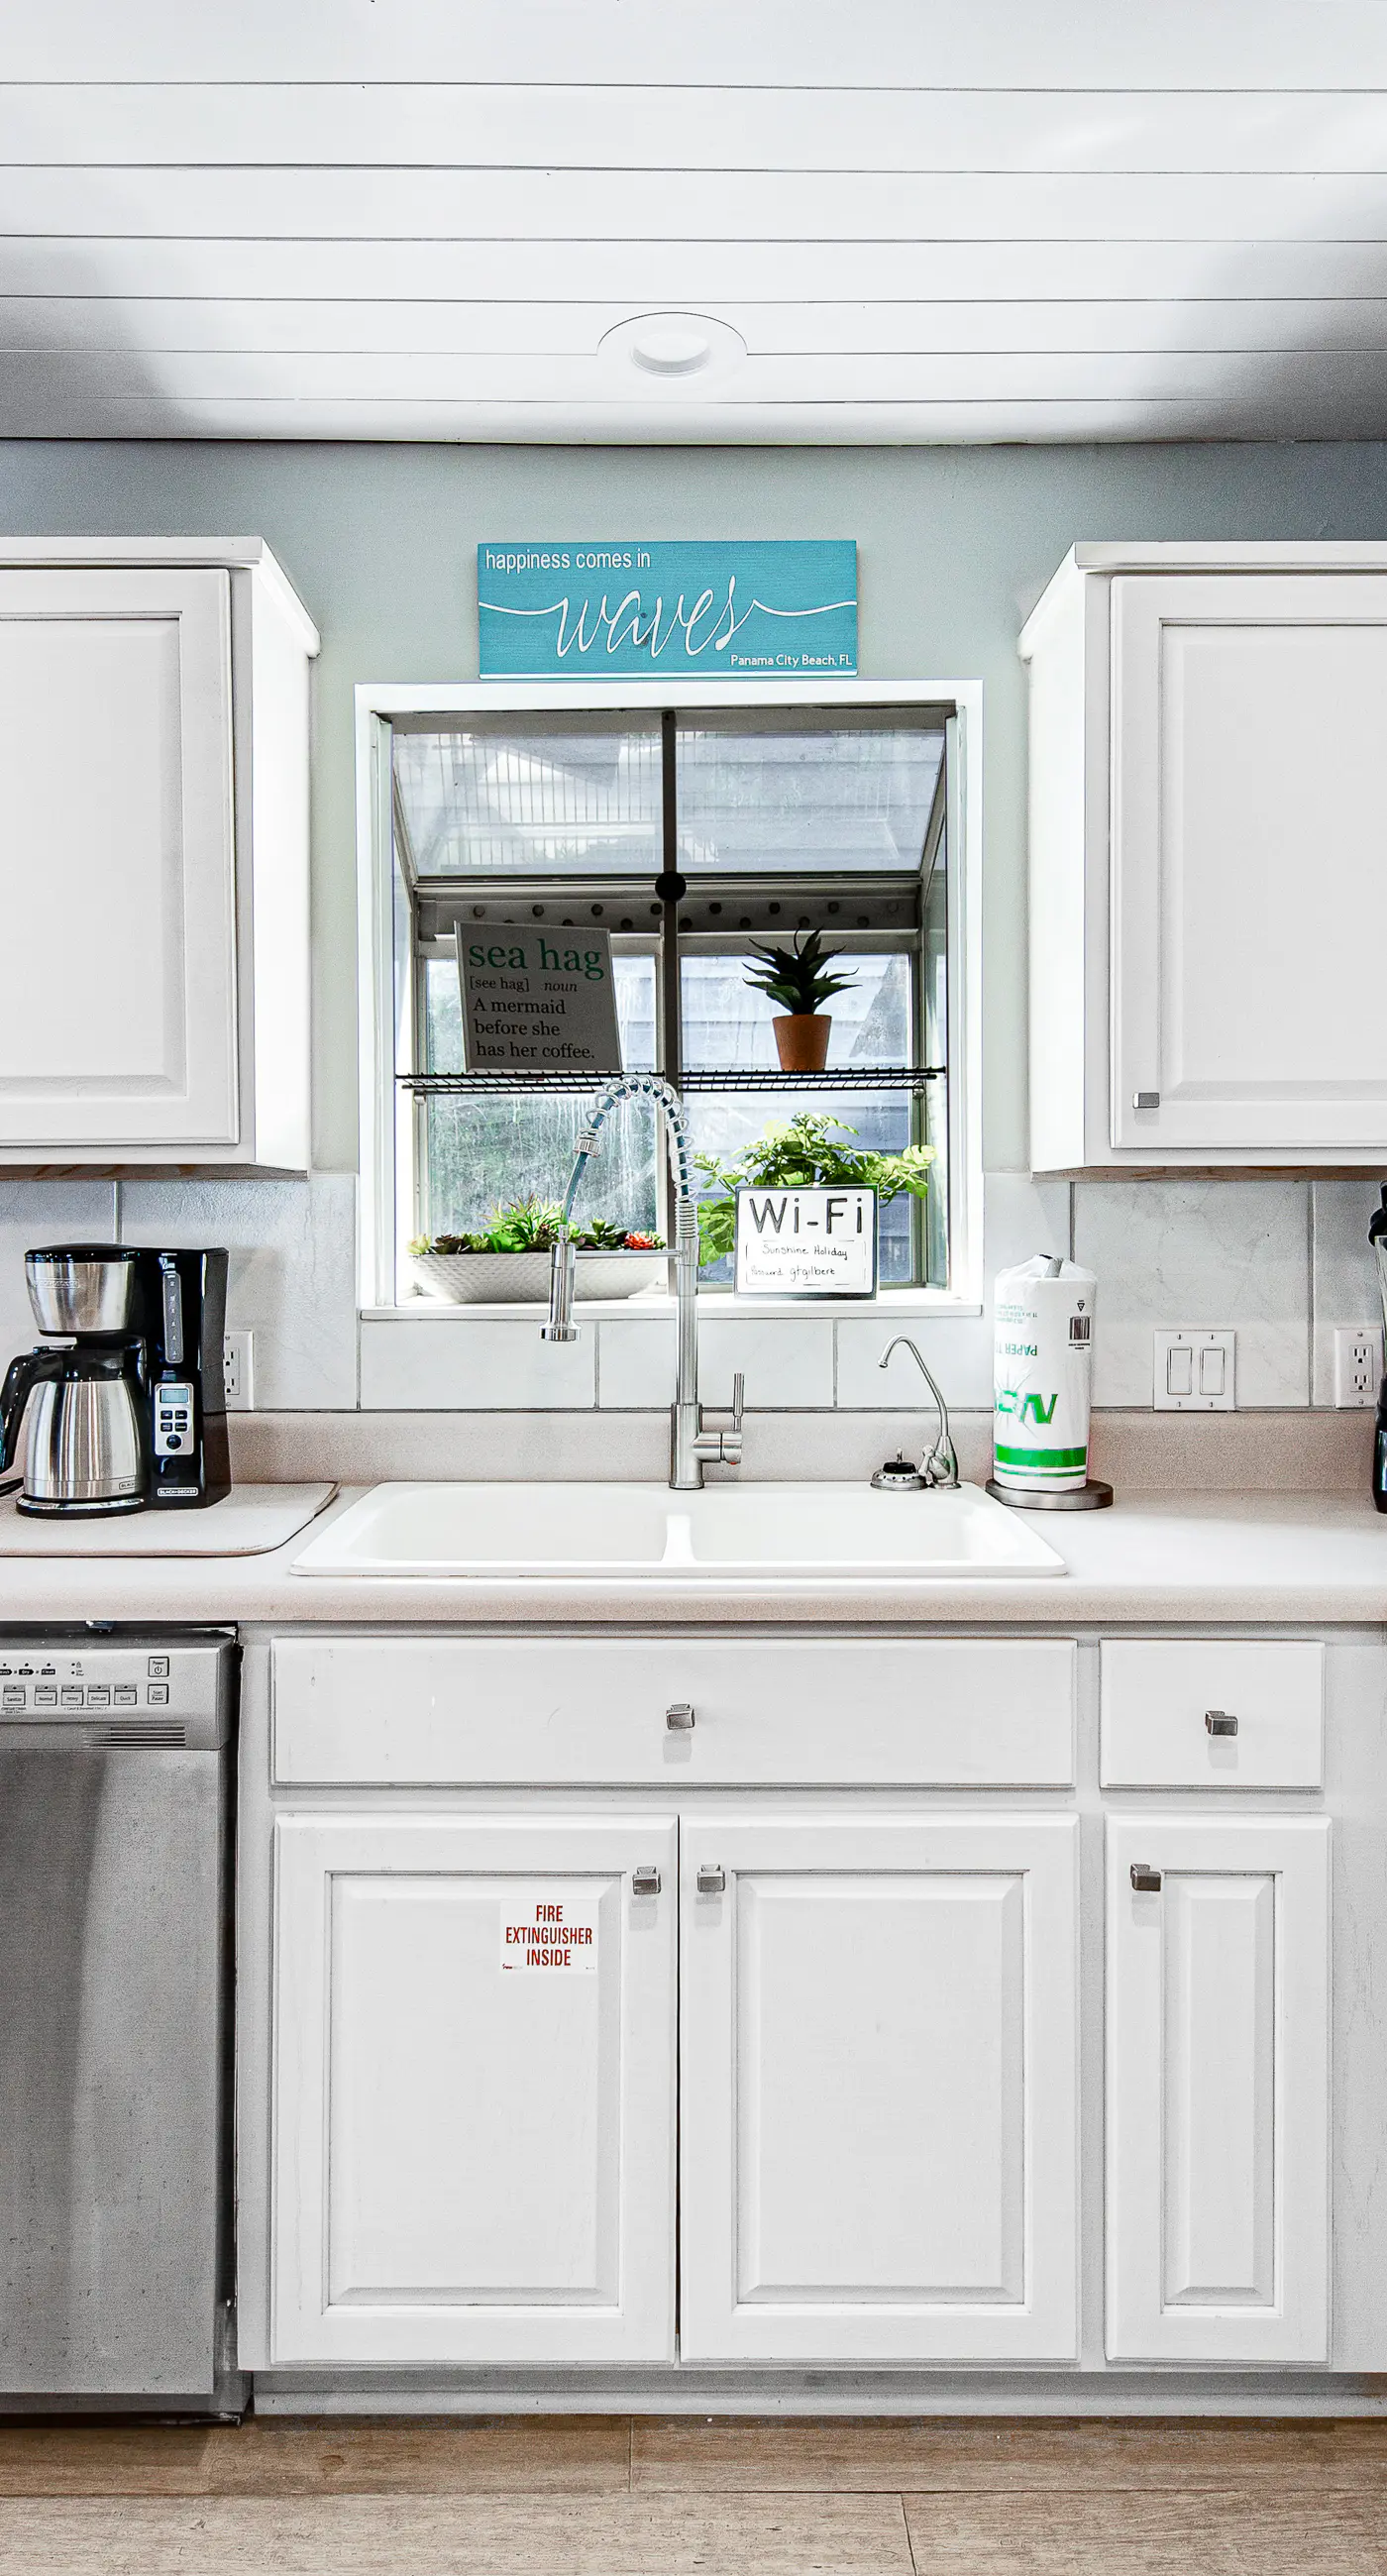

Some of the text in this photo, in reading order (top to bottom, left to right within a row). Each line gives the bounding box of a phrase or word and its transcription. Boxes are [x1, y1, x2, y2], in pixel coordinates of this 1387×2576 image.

[485, 548, 651, 575] happiness comes in
[556, 575, 754, 658] waves
[730, 654, 853, 668] Panama City Beach, FL
[469, 938, 605, 981] sea hag
[470, 976, 578, 992] [see hag] noun
[473, 998, 567, 1015] A mermaid
[474, 1019, 561, 1035] before she
[477, 1040, 595, 1059] has her coffee.
[749, 1197, 863, 1234] Wi-Fi
[762, 1243, 848, 1260] Sunshine Holiday
[1005, 1342, 1038, 1356] PAPER
[536, 1904, 563, 1922] FIRE
[505, 1926, 592, 1945] EXTINGUISHER
[526, 1949, 572, 1967] INSIDE
